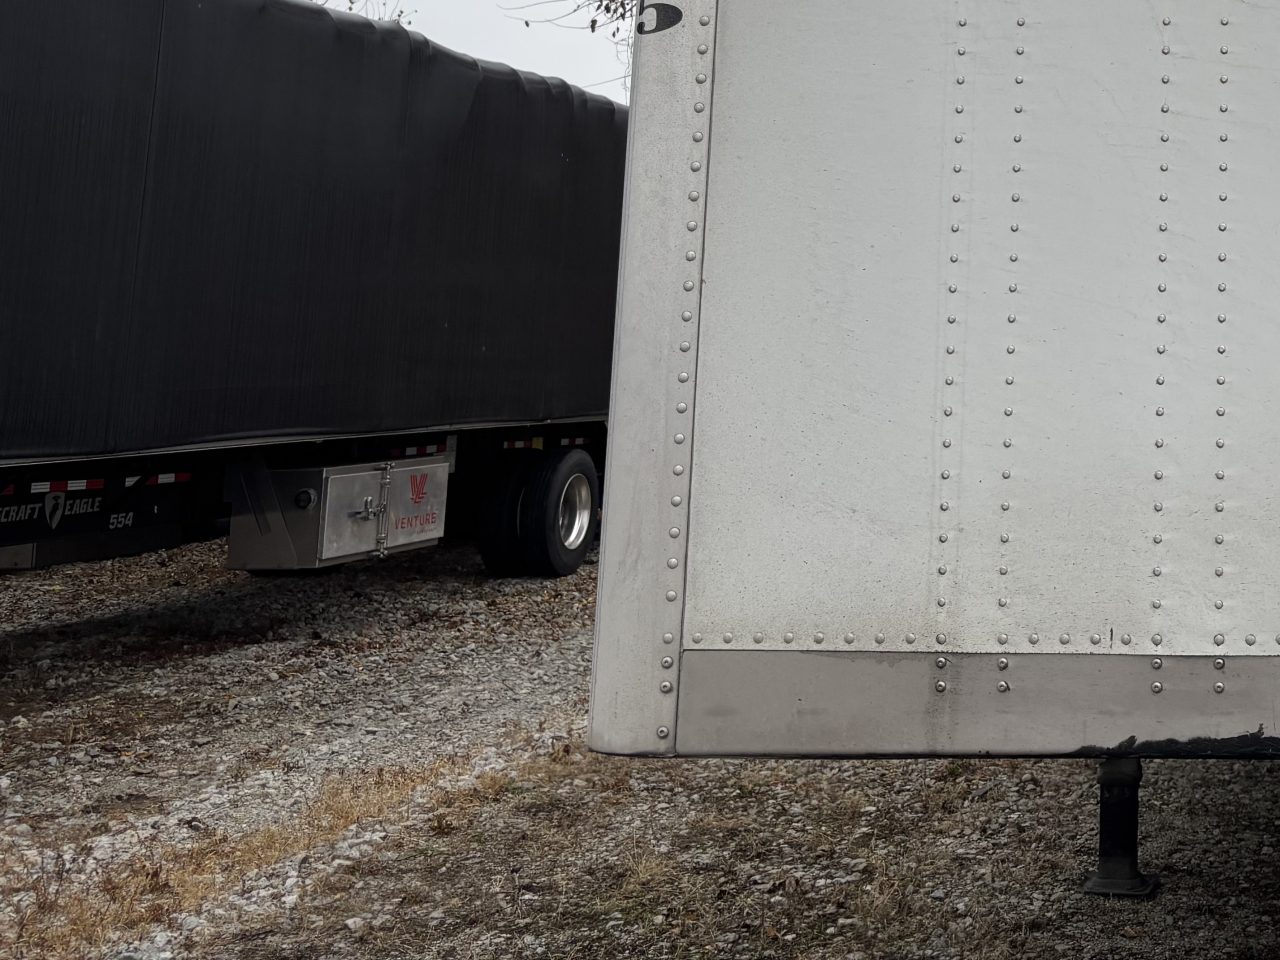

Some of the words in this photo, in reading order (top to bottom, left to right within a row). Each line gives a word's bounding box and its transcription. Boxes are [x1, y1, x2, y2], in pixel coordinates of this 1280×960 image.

[64, 497, 102, 515] EAGLE
[109, 512, 134, 530] 554
[394, 511, 437, 530] VENTURE
